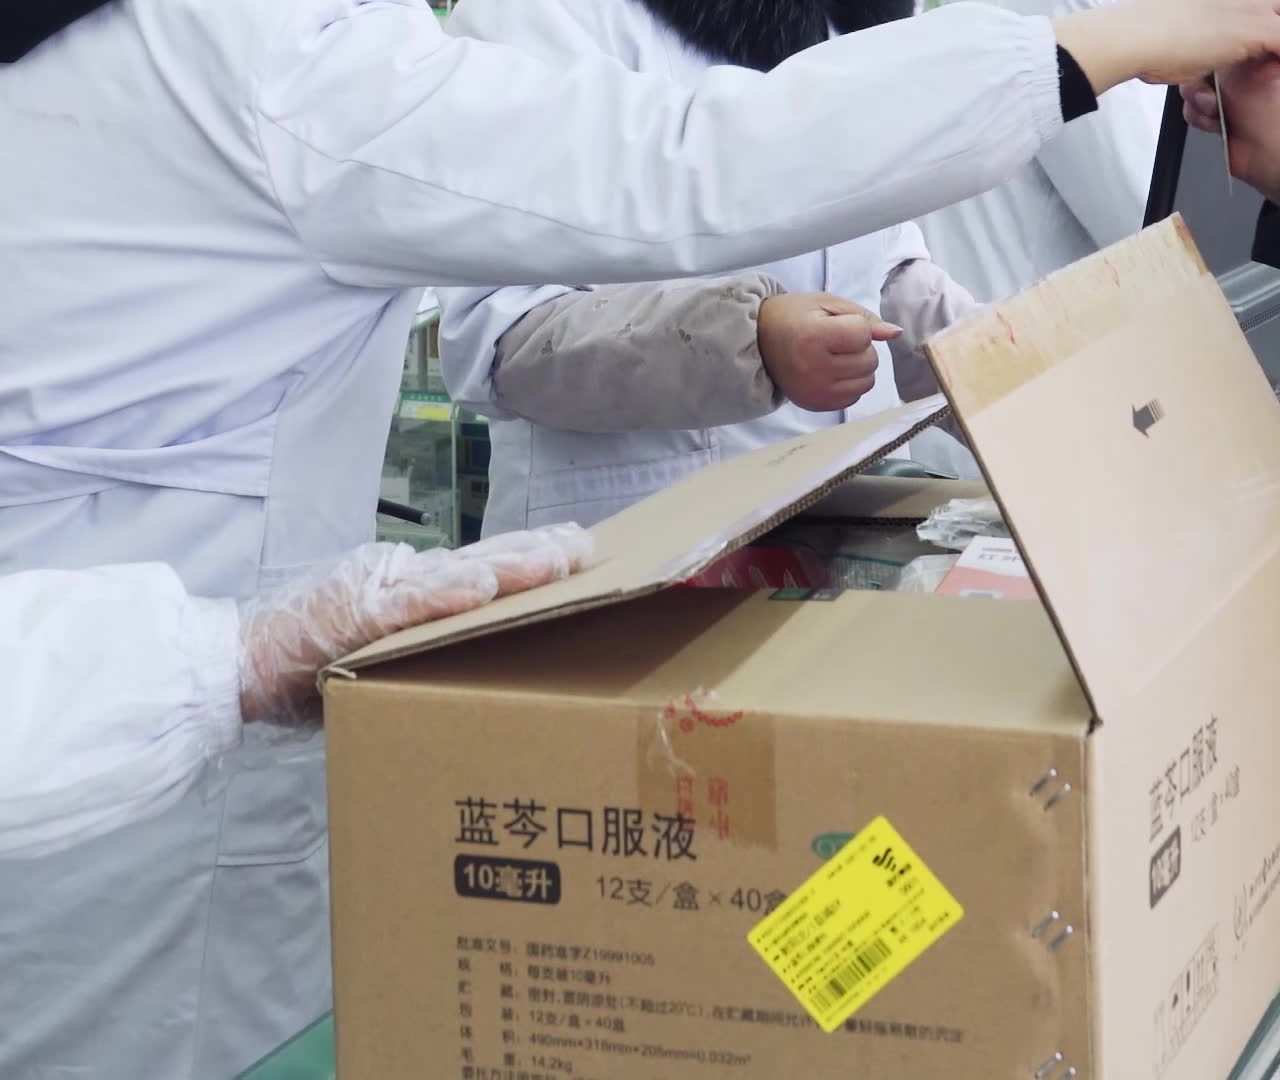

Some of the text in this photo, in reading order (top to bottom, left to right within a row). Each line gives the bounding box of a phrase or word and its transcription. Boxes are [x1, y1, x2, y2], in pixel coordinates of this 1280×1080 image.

[454, 796, 698, 861] 蓝芩口服液
[463, 862, 554, 900] 10毫升
